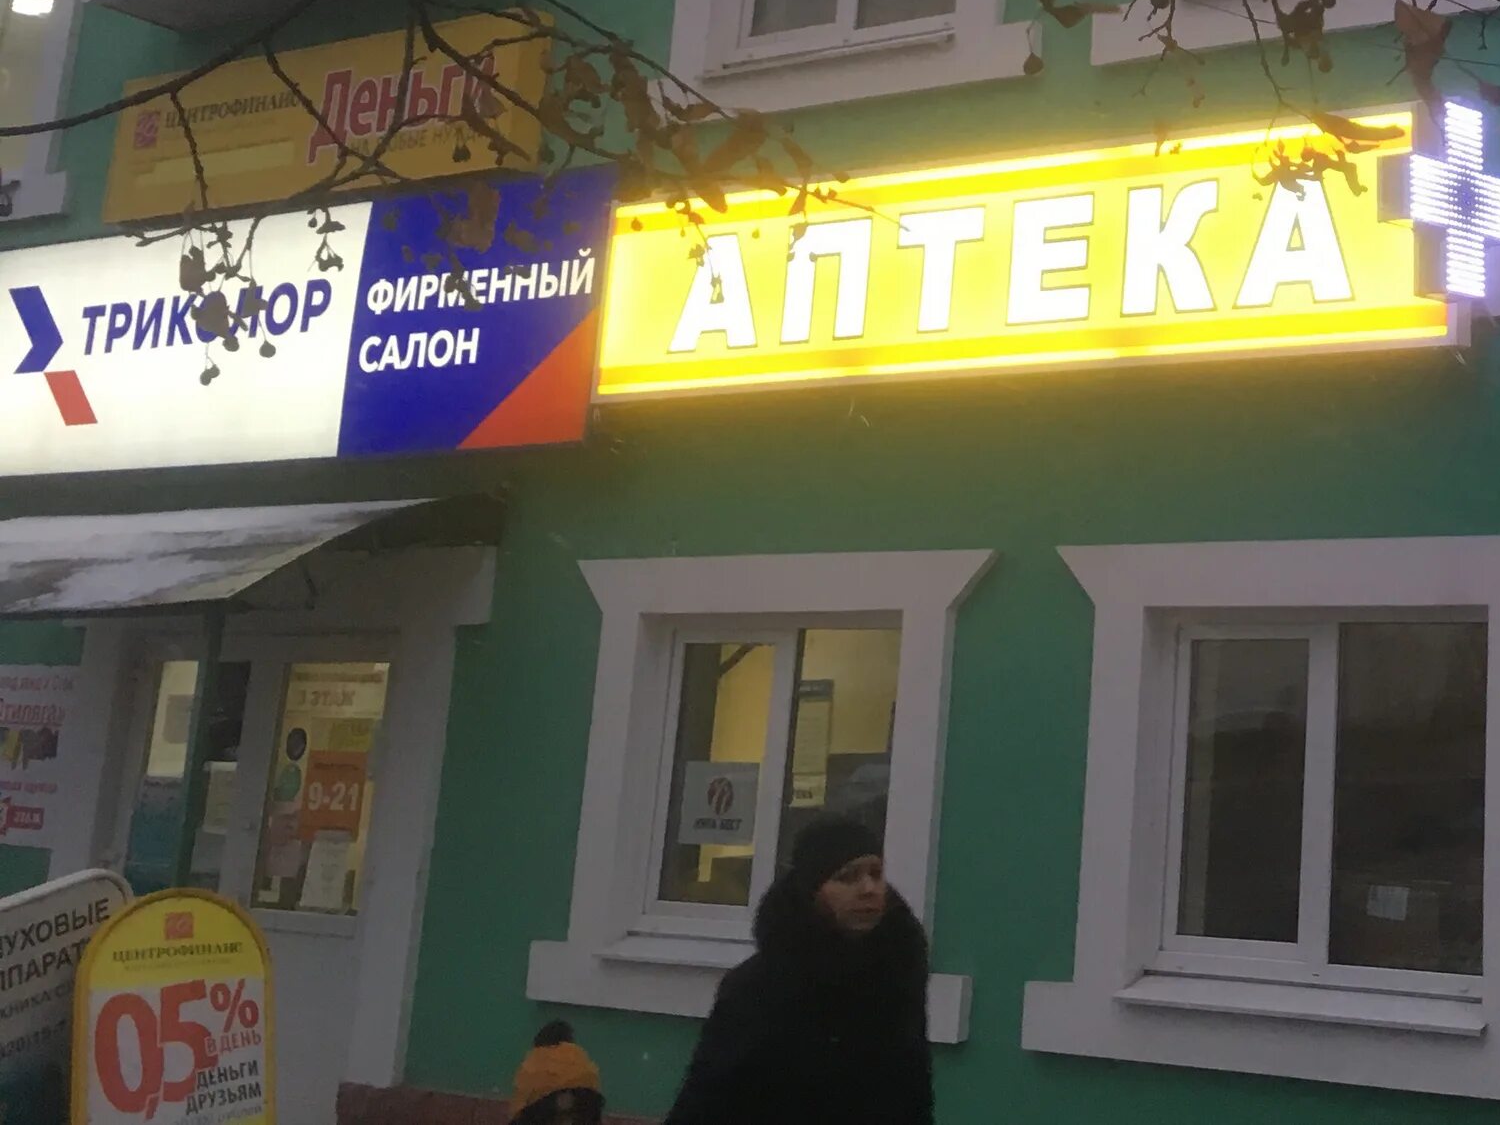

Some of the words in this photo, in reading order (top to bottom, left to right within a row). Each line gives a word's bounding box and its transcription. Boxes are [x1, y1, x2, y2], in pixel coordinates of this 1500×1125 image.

[366, 248, 596, 315] ФИРМЕННЫЙ
[666, 175, 1354, 355] АПТЕКА
[358, 327, 480, 373] САЛОН
[308, 781, 360, 812] 9-21
[0, 898, 111, 960] УХОВЫЕ
[0, 936, 91, 991] ПАРАТ
[218, 1029, 262, 1054] ДЕНЬ
[196, 1059, 259, 1089] ДЕНЬГИ
[185, 1082, 262, 1115] ДРУЗЬЯМ
